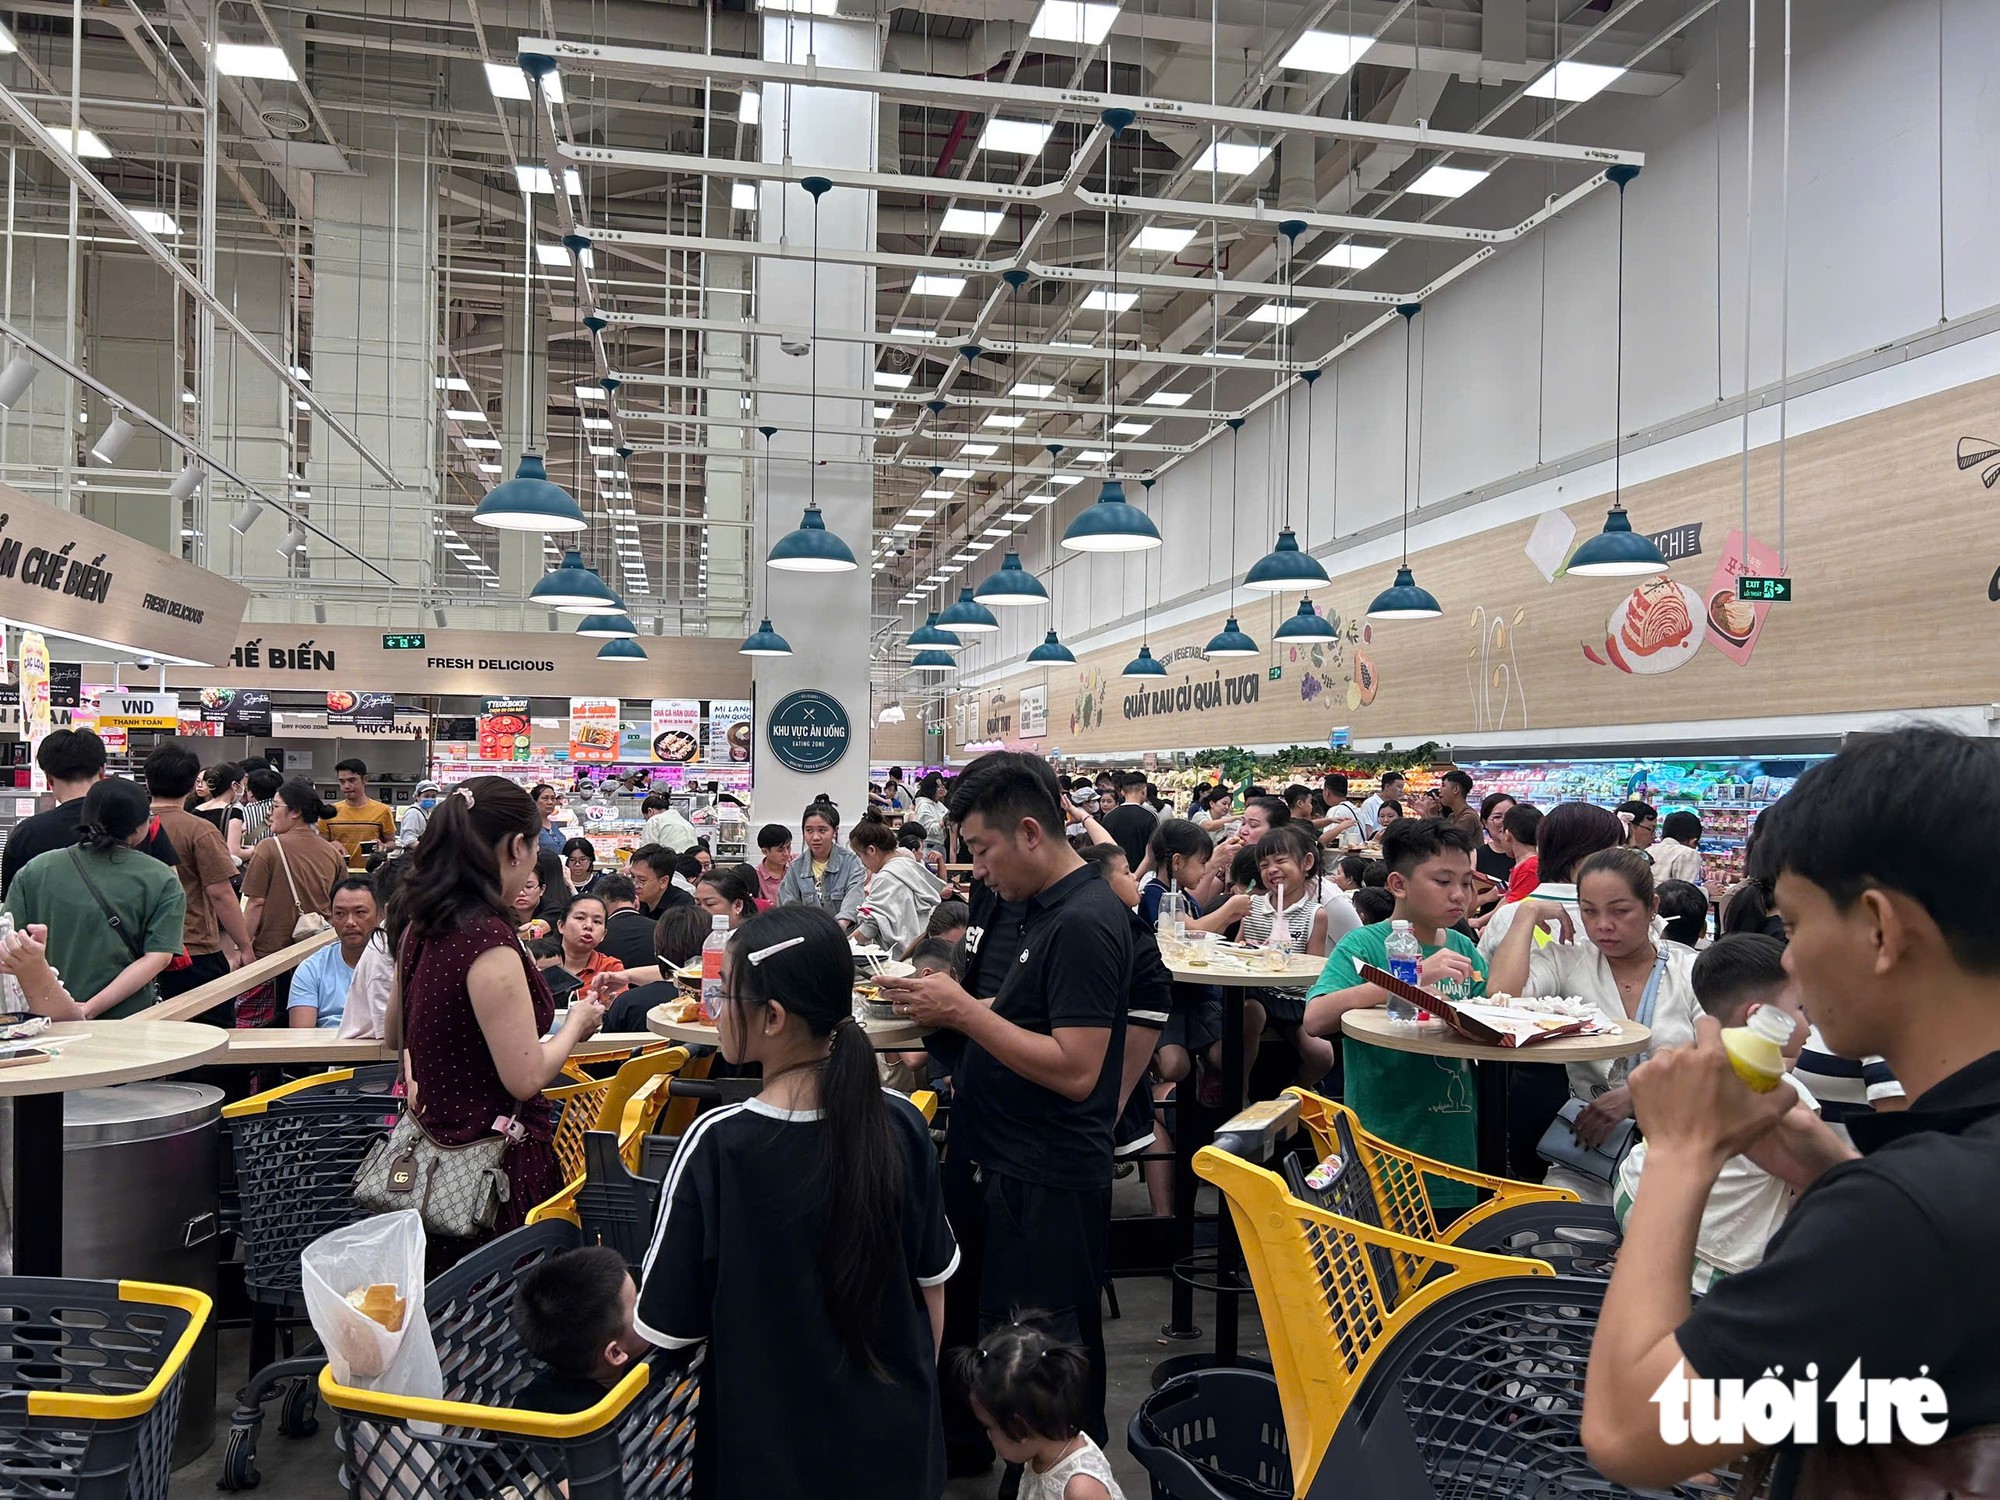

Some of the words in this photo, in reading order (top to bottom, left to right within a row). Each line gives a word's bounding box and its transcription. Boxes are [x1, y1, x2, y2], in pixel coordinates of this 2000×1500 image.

[21, 542, 76, 591] CHẾ
[63, 554, 113, 604] BIẾN
[1746, 580, 1761, 588] EXIT
[142, 593, 169, 614] FRESH
[167, 600, 205, 625] DELICIOUS
[268, 640, 335, 671] BIẾN
[427, 657, 474, 670] FRESH
[478, 659, 555, 672] DELICIOUS
[1152, 688, 1174, 714] RAU
[1176, 675, 1191, 712] CỦ
[1193, 669, 1222, 711] QUẢ
[1225, 673, 1259, 705] TƯƠI
[122, 700, 154, 714] VND
[389, 722, 422, 734] PHẨM
[773, 725, 790, 737] KHU
[791, 725, 808, 740] VỰC
[810, 724, 821, 737] ĂN
[823, 723, 845, 737] UỐNG
